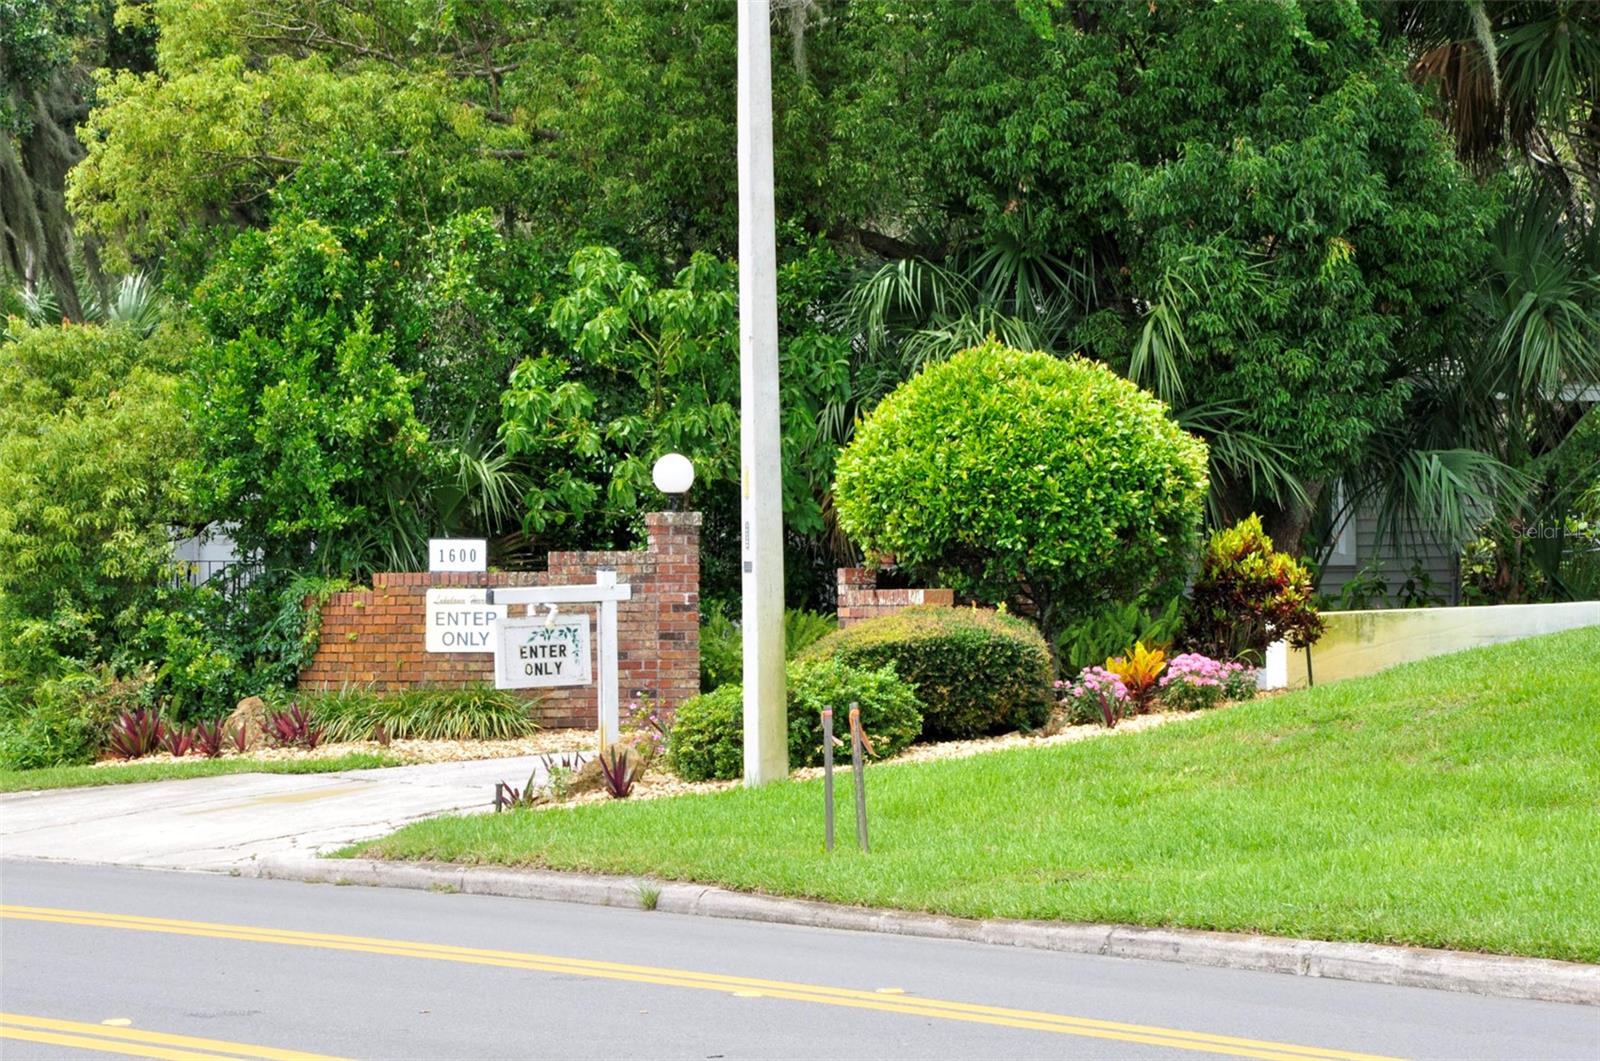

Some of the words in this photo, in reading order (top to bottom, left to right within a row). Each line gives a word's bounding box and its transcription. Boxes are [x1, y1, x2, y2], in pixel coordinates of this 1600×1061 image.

[439, 548, 477, 563] 1600
[442, 631, 490, 647] ONLY
[519, 644, 567, 660] ENTER
[524, 661, 563, 676] ONLY
